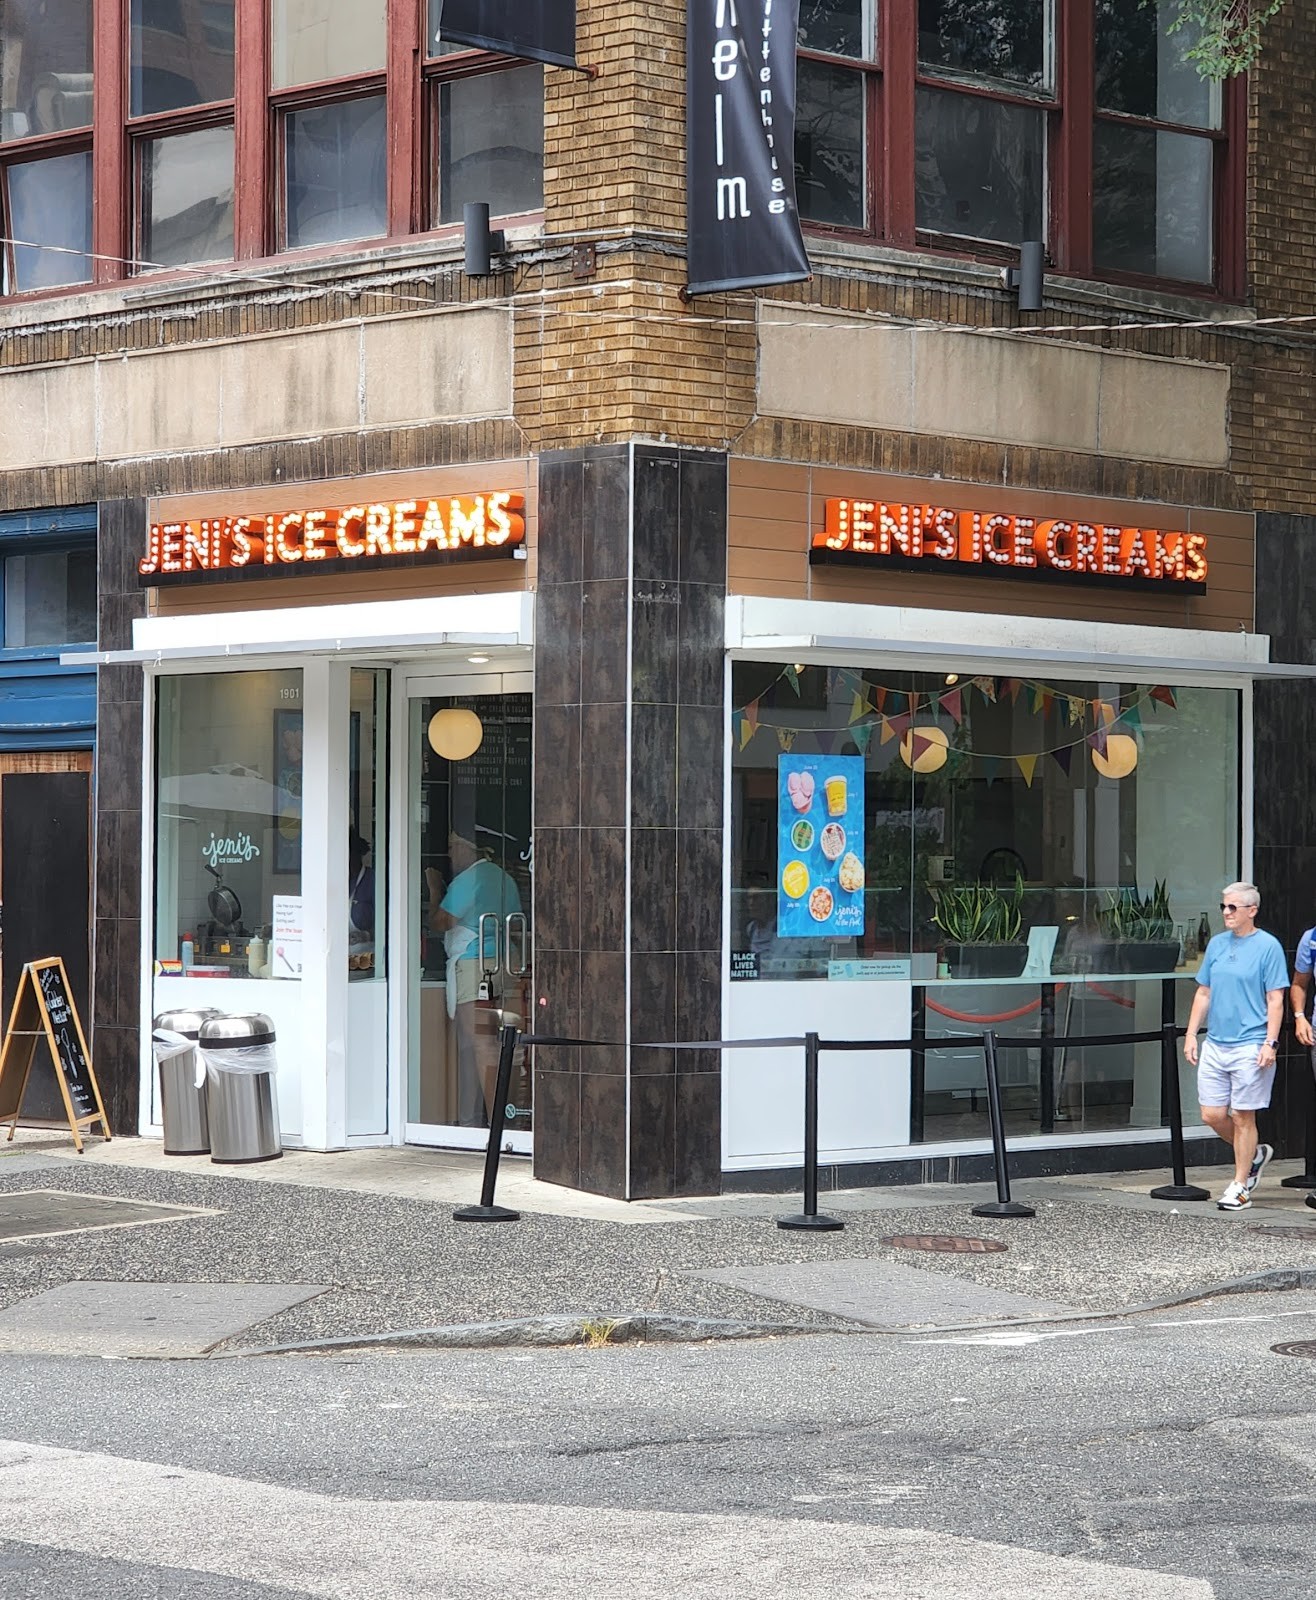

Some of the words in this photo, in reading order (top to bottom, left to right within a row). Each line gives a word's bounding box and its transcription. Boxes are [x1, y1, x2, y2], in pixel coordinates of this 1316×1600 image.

[139, 515, 256, 576] JENI'S
[264, 510, 331, 565] ICE
[336, 491, 518, 558] CREAMS
[818, 498, 957, 561] JENI'S
[964, 512, 1037, 567] ICE
[1040, 519, 1208, 582] CREAMS
[279, 688, 300, 699] 1901
[202, 831, 260, 867] jeni's
[732, 952, 756, 961] BLACK
[734, 961, 754, 970] LIVES
[731, 970, 758, 978] MATTER
